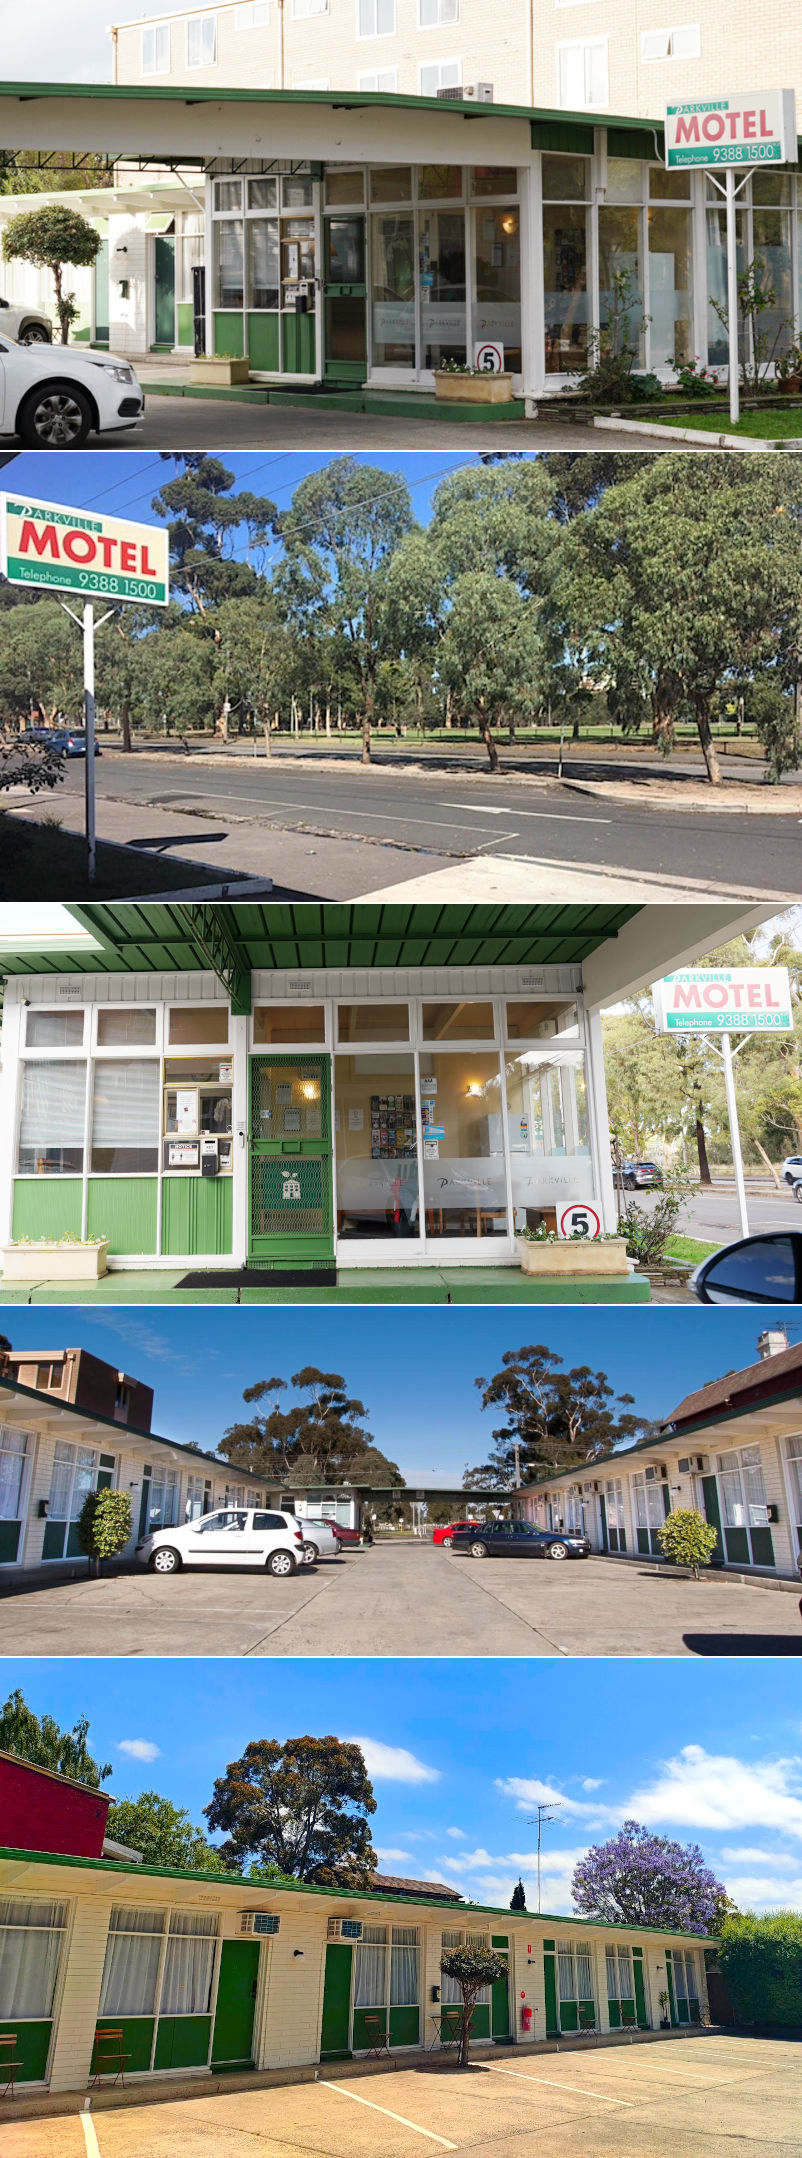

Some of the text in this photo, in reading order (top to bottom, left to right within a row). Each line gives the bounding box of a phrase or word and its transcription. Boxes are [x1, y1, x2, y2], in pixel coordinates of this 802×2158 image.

[672, 102, 727, 114] PARKVILLE
[675, 109, 774, 144] MOTEL
[675, 144, 774, 165] Telephone 9388 1500
[483, 352, 495, 371] 5
[15, 503, 98, 532] PARKVILLE
[18, 520, 157, 576] MOTEL
[19, 567, 157, 598] Telephone 9388 1500
[672, 974, 730, 983] PARKVILLE
[673, 983, 780, 1009] MOTEL
[674, 1014, 781, 1028] Telephone 9388 1500
[571, 1213, 590, 1236] 5
